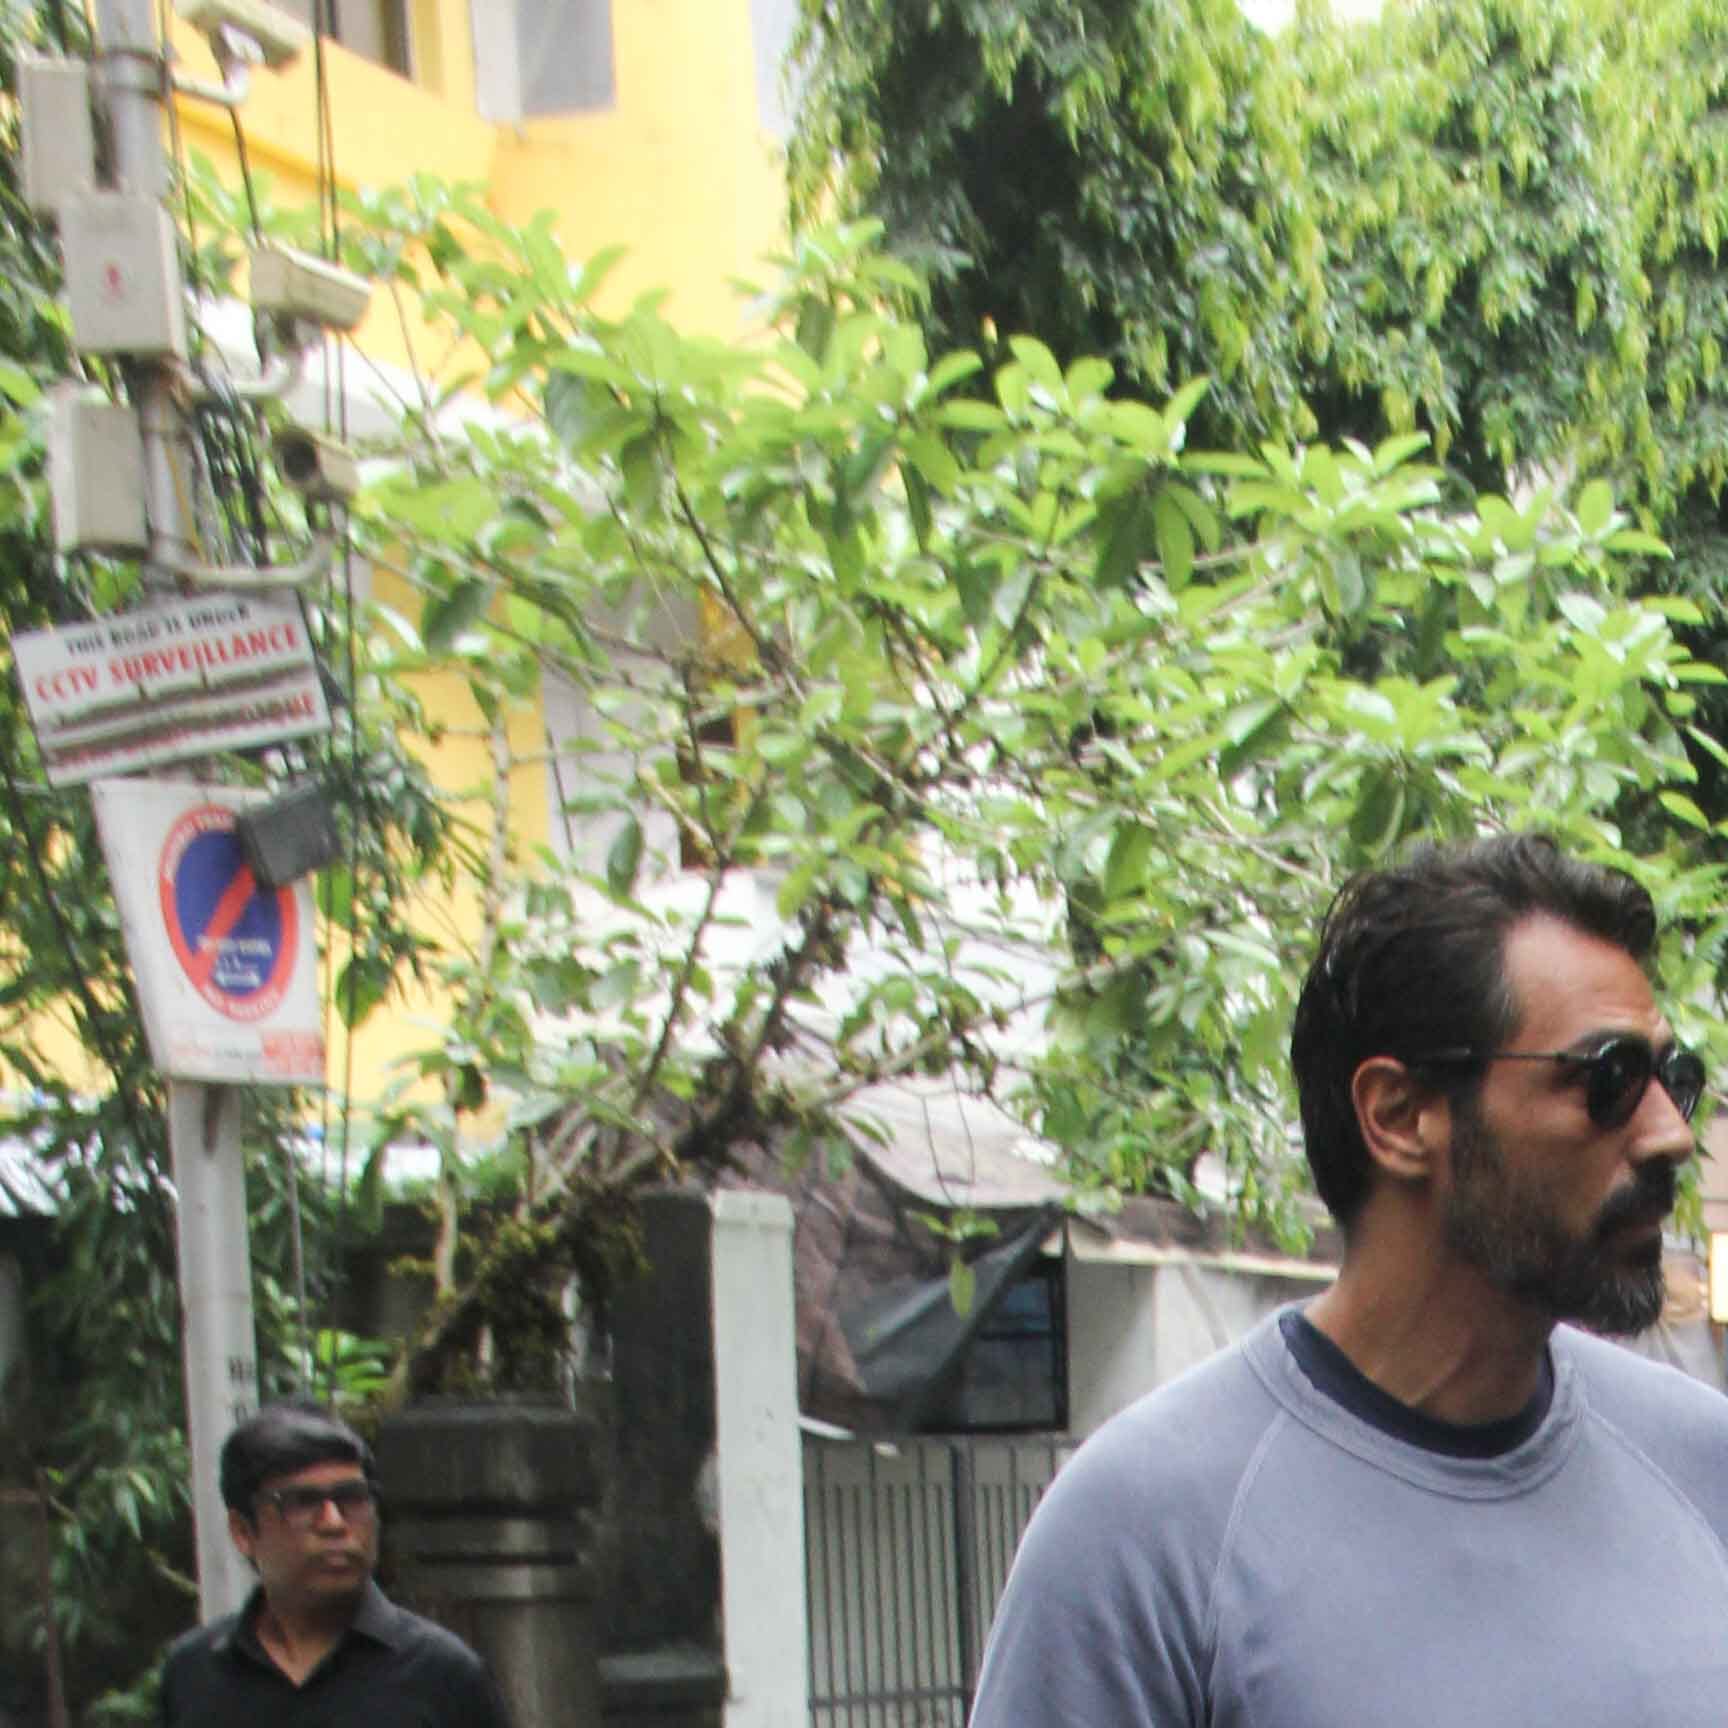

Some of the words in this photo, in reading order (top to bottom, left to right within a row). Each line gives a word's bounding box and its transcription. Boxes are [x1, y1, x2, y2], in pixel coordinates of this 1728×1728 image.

[188, 604, 251, 629] UNDER
[35, 664, 99, 702] CCTV
[108, 624, 299, 685] SURVEILLANCE
